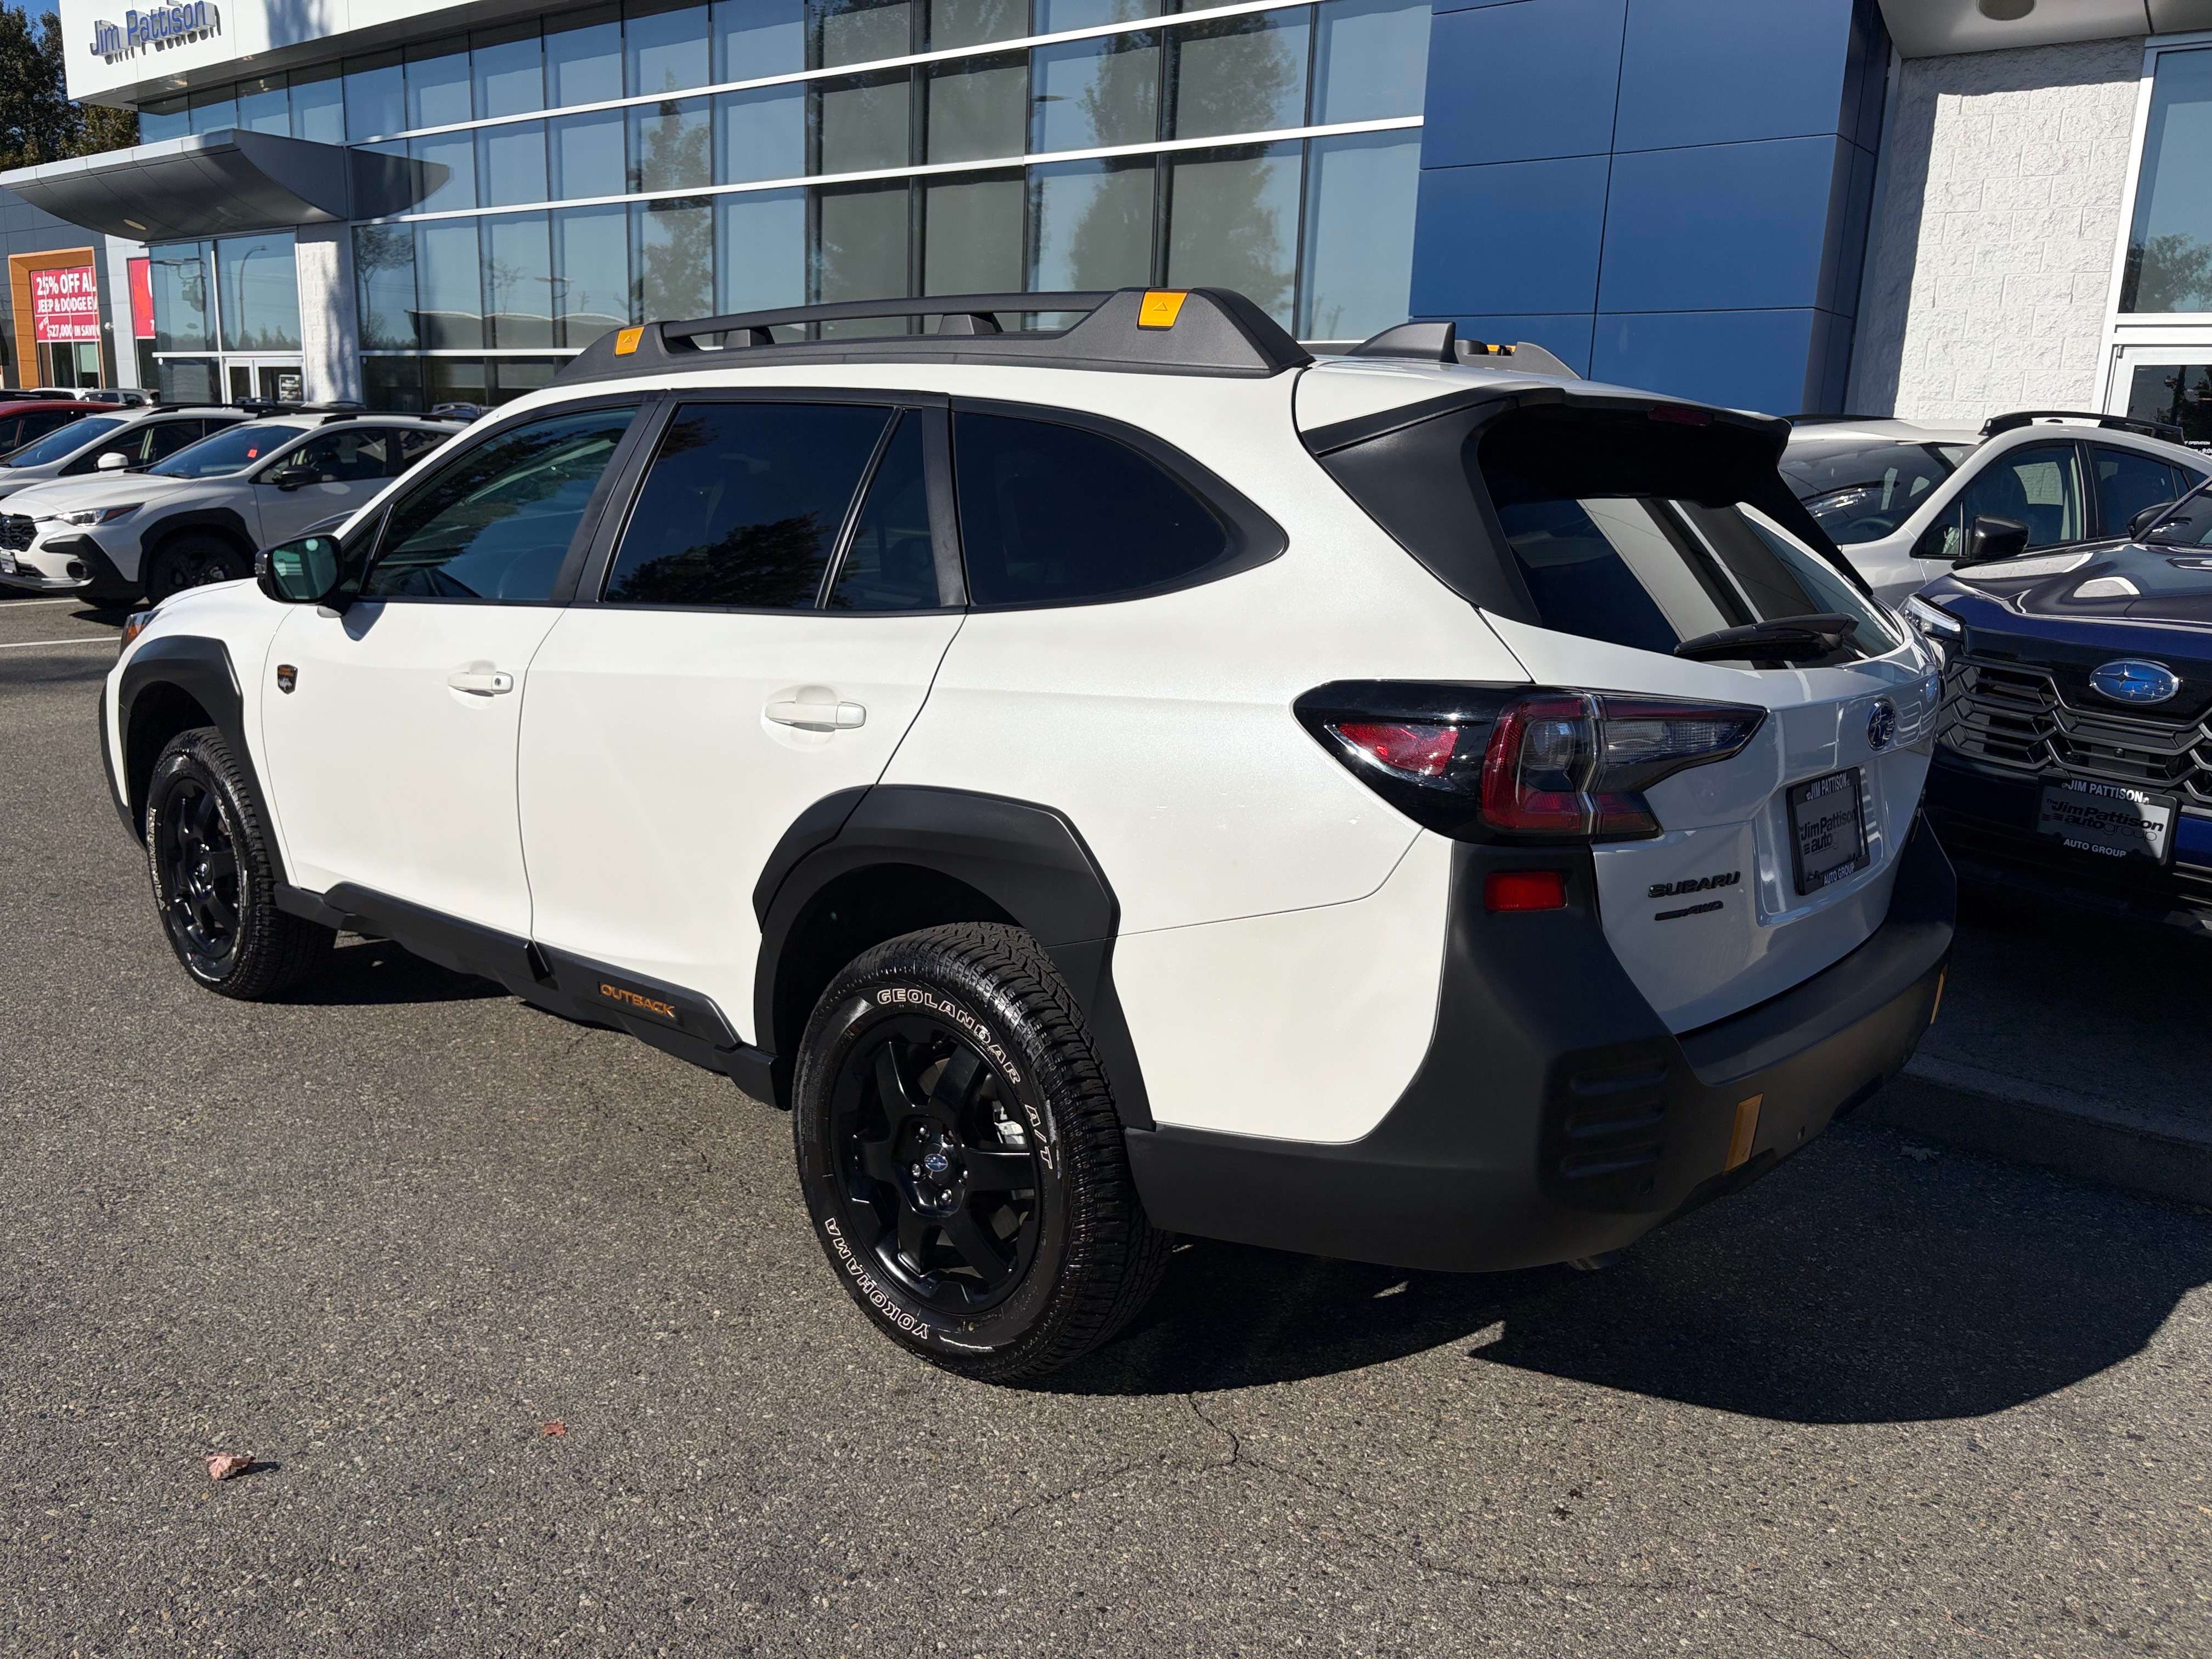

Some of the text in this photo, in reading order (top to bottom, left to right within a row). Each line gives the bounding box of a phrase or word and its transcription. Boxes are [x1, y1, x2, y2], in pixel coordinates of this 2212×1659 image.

[90, 0, 207, 56] Jim Pattison
[36, 275, 59, 296] 25%
[60, 273, 80, 294] OFF
[37, 298, 54, 313] JEEP
[54, 298, 60, 312] &
[60, 297, 87, 312] DODGE
[47, 324, 72, 339] $27,000
[74, 325, 81, 337] IN
[1811, 772, 1847, 800] JIM PATTISON
[2067, 780, 2144, 803] JIM PATTISON
[2063, 838, 2127, 858] AUTO GROUP
[1647, 871, 1741, 898] SUBARU
[1824, 862, 1855, 887] AUTO GROUP
[1686, 900, 1724, 915] AWD
[600, 983, 676, 1018] OUTBACK
[877, 988, 1053, 1170] GEOLANDAR A/T
[825, 1217, 928, 1340] YOKOHAMA
